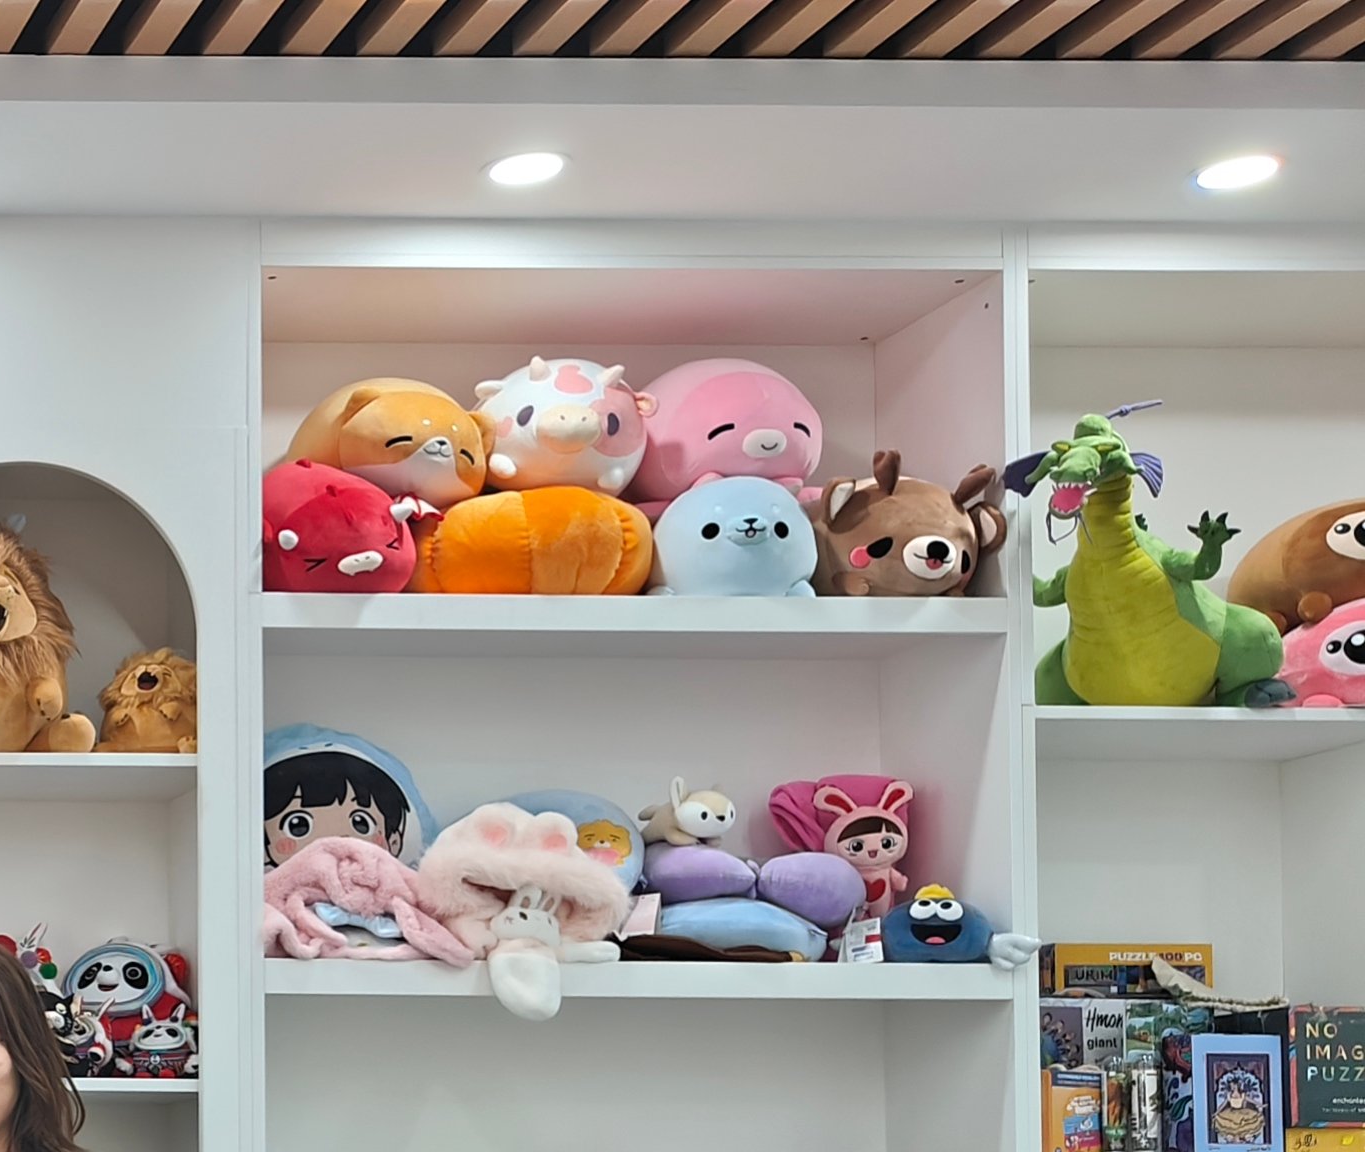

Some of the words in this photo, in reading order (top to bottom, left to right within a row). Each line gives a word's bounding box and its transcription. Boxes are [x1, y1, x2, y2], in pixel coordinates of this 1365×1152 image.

[1306, 1022, 1338, 1039] NO
[1087, 1037, 1118, 1051] giant
[1306, 1044, 1365, 1060] IMAG
[1307, 1066, 1365, 1082] PUZZ
